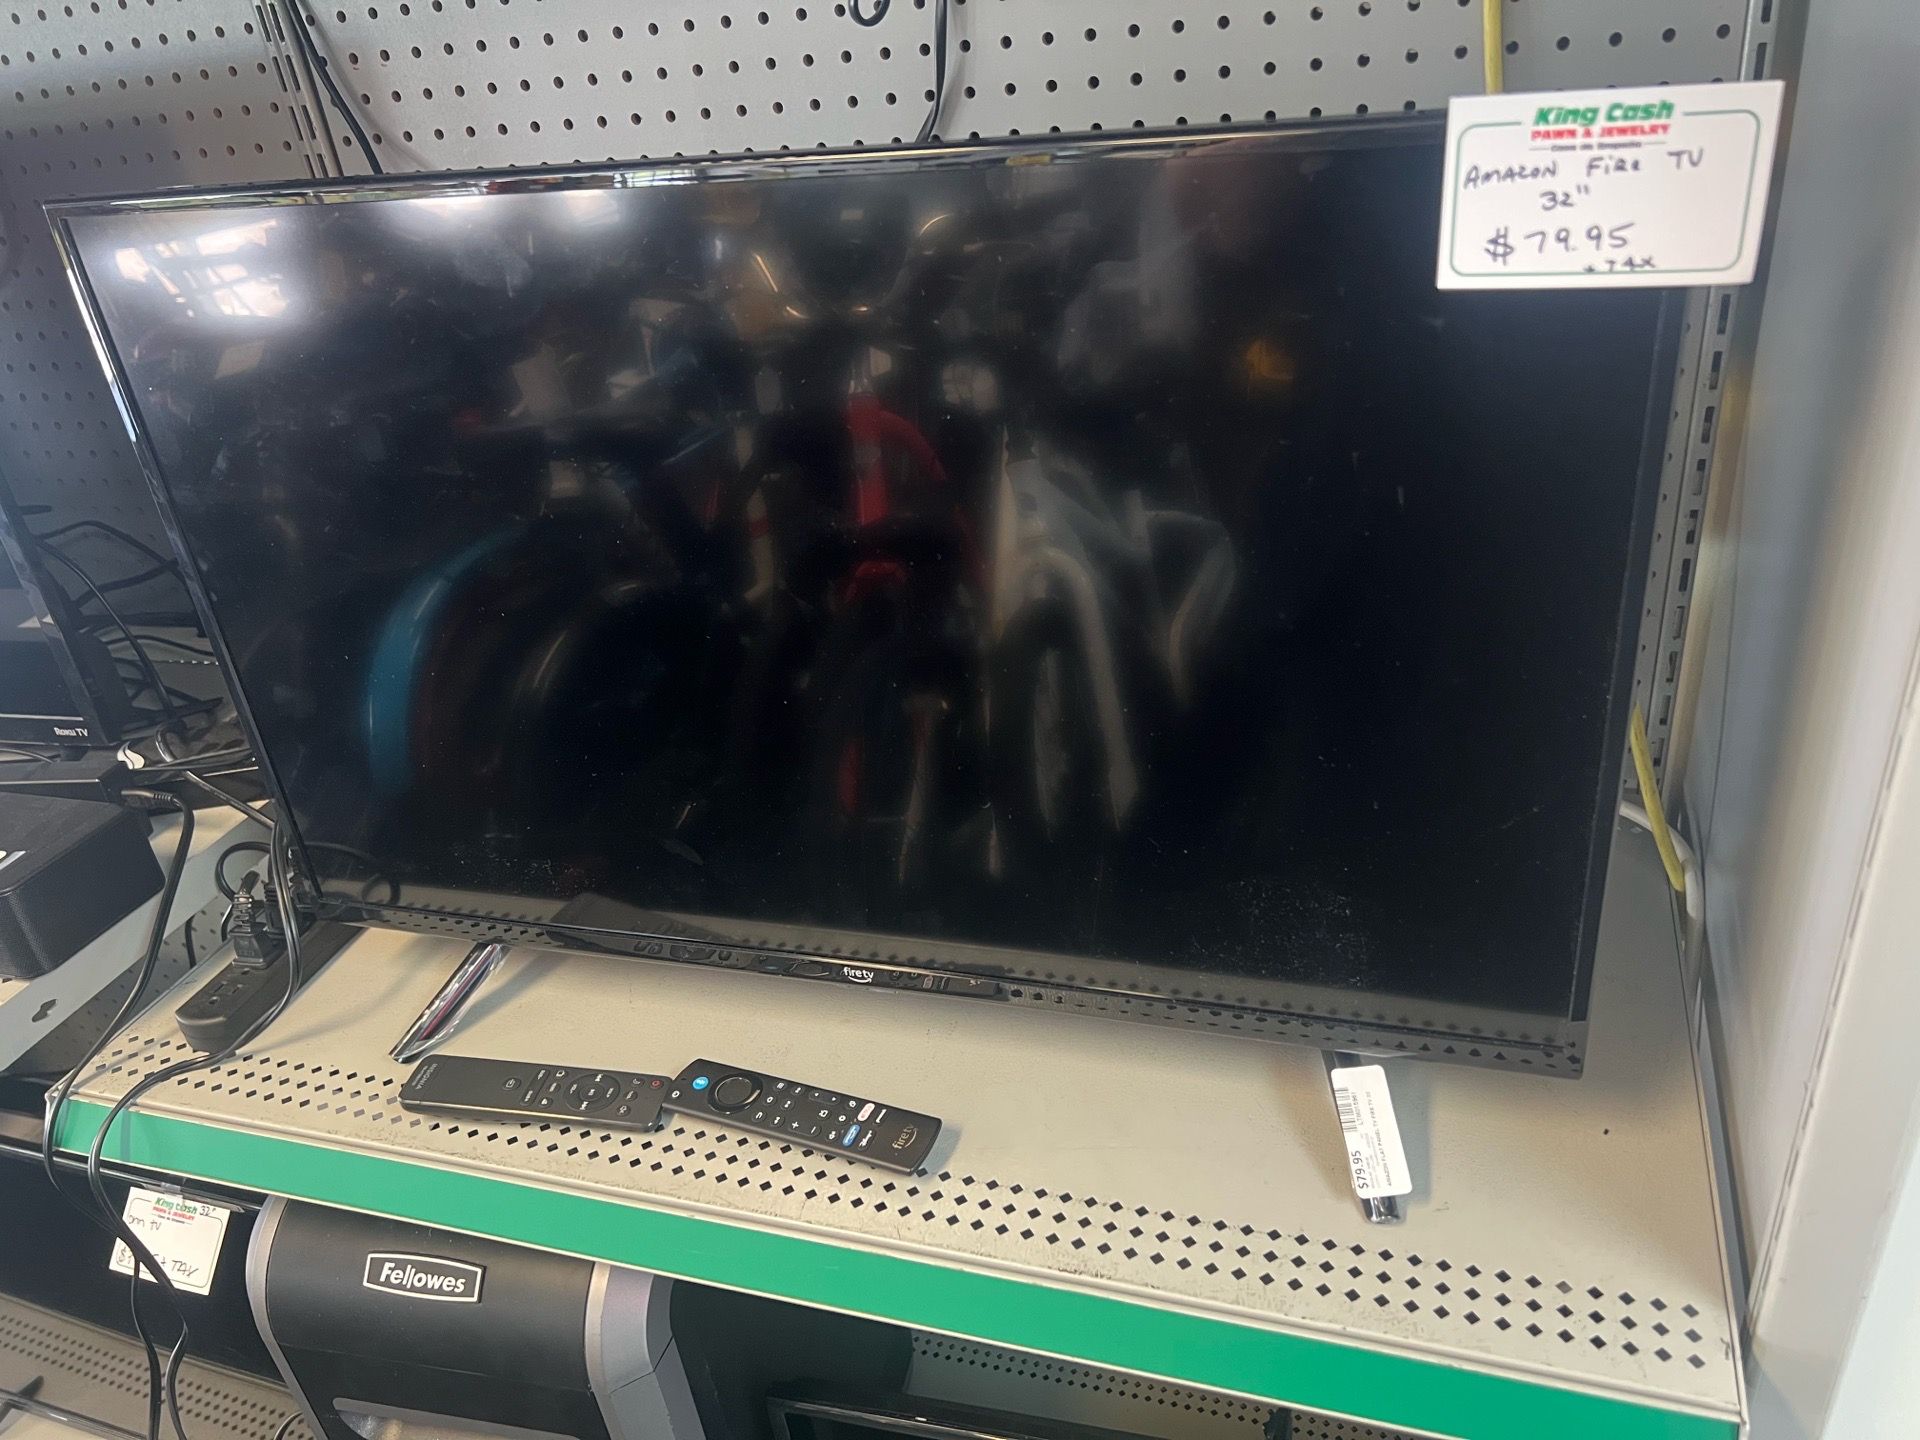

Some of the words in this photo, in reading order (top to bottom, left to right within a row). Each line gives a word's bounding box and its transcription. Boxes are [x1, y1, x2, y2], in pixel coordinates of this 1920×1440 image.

[1534, 107, 1600, 126] King
[1605, 99, 1676, 122] Cash
[1601, 123, 1671, 137] JEWELRY
[1667, 148, 1704, 170] TV
[75, 728, 88, 736] TV
[1351, 1150, 1370, 1190] $79.95
[379, 1261, 466, 1293] Fellowes
